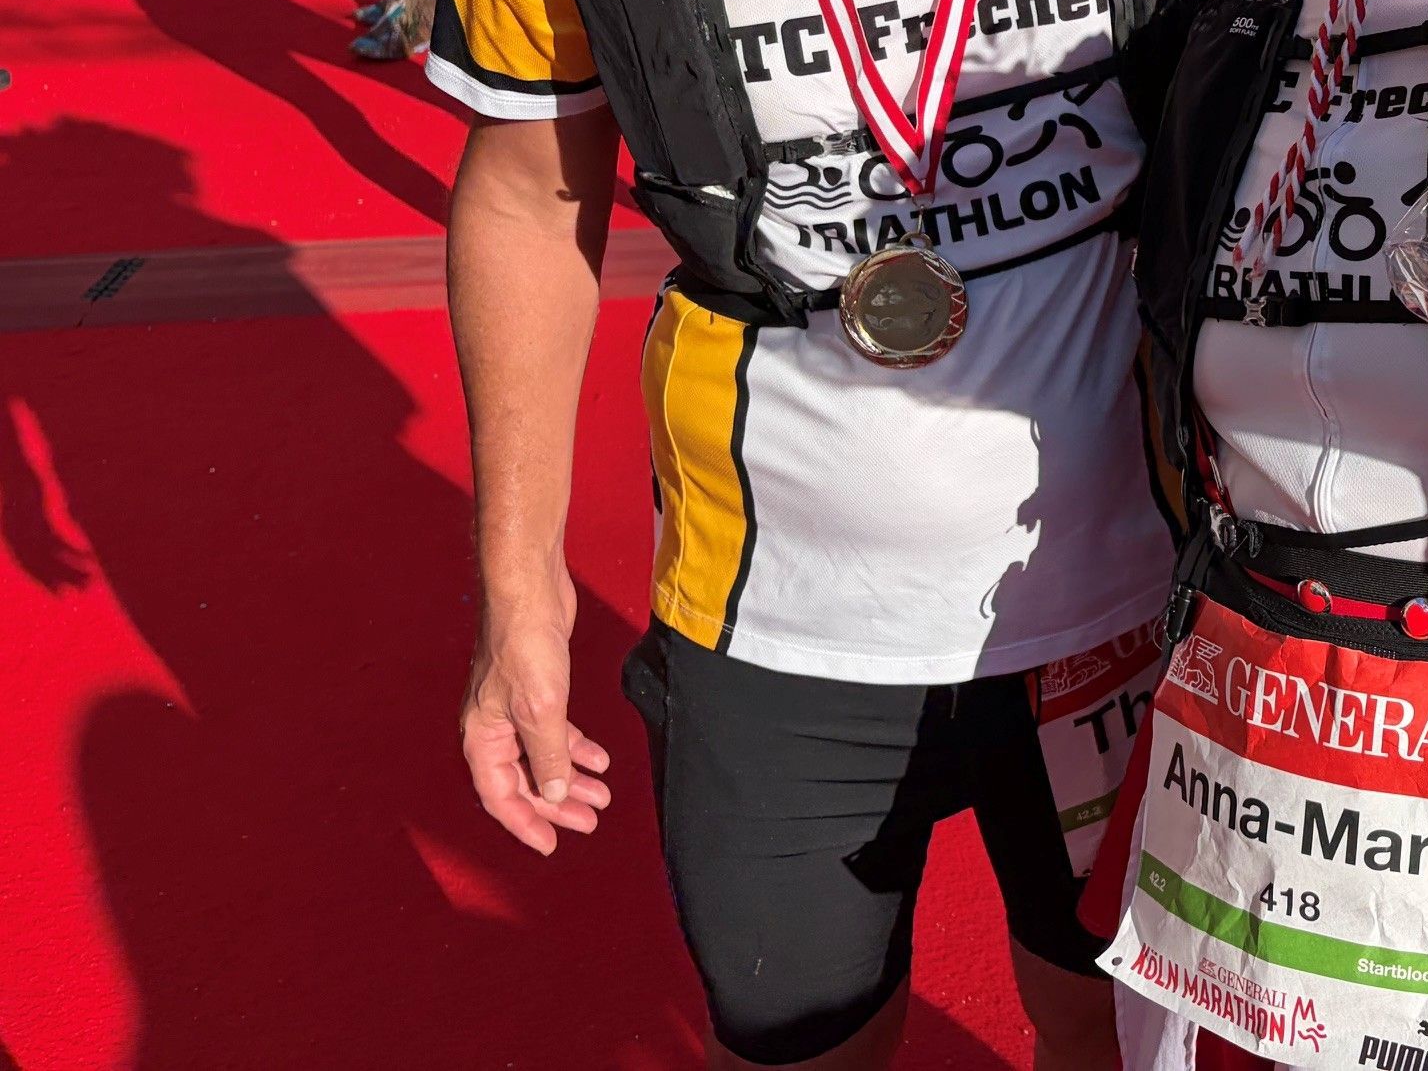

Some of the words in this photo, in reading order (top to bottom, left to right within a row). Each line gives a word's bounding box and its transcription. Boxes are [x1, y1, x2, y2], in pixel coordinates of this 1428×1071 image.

[729, 14, 832, 84] TC
[1259, 881, 1321, 923] 418
[1130, 942, 1179, 994] KÖLN
[1181, 967, 1286, 1044] MARATHON
[1217, 965, 1288, 1010] GENERALI
